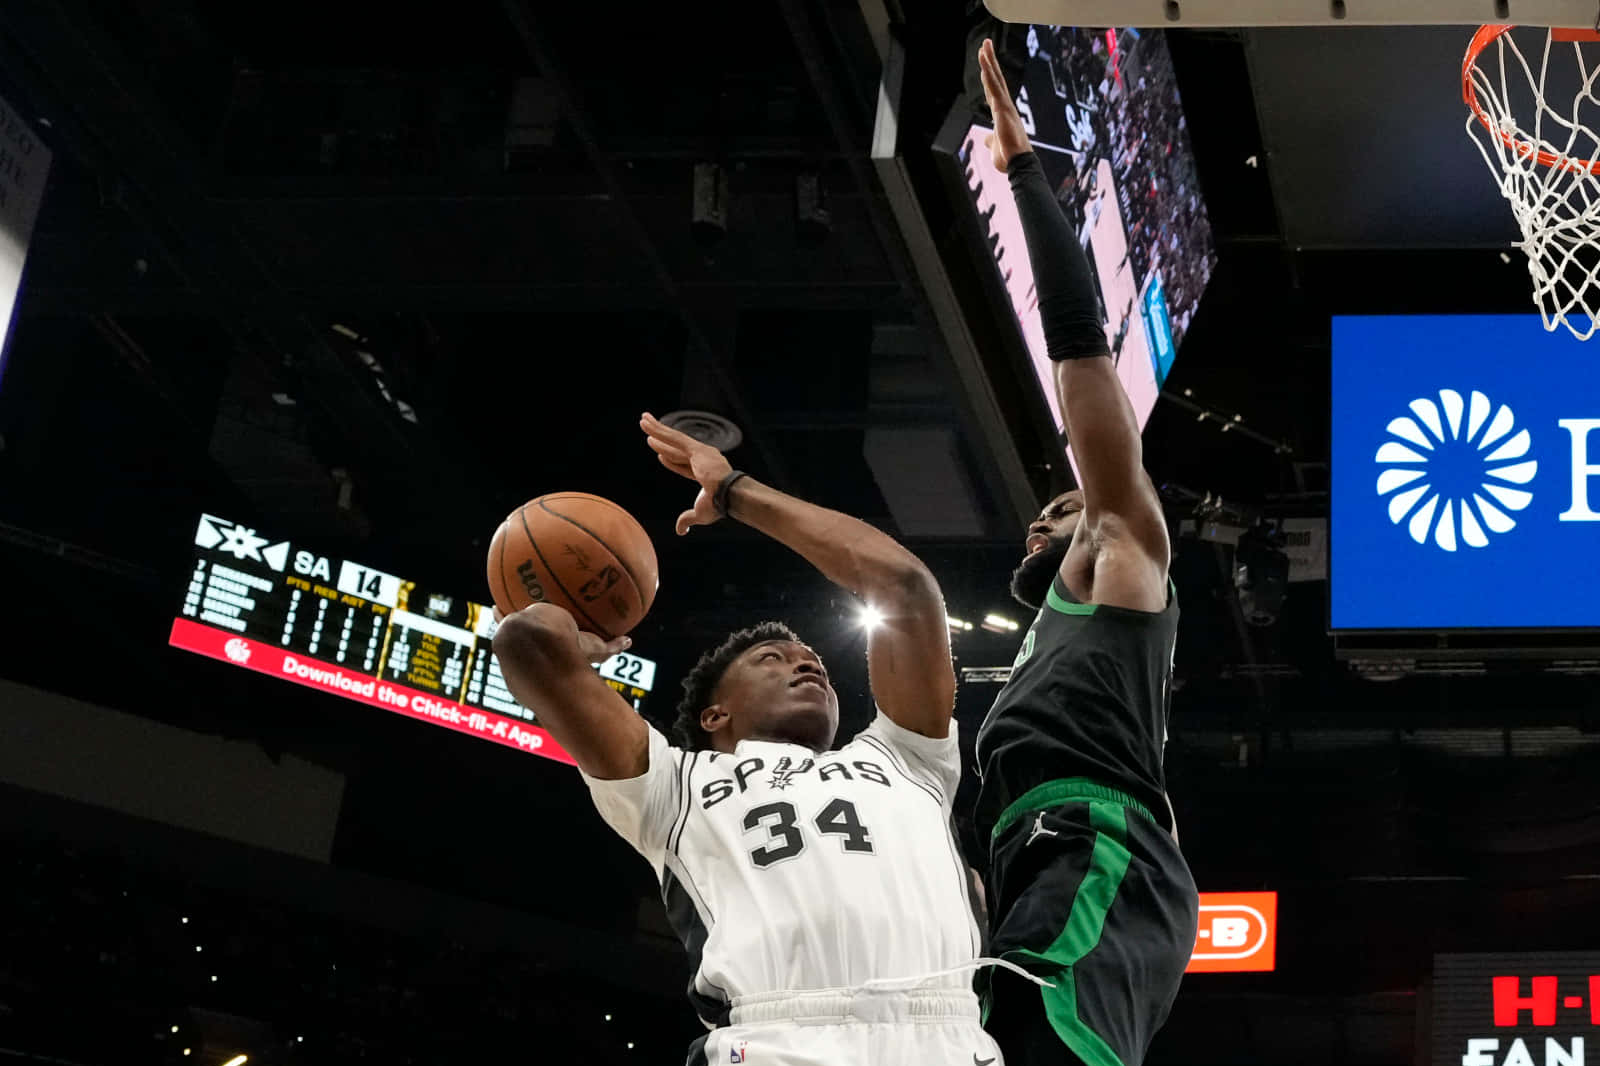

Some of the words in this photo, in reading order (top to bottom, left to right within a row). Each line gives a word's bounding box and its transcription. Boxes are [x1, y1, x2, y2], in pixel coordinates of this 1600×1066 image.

[294, 550, 330, 581] SA
[357, 570, 382, 599] 14
[614, 655, 643, 683] 22
[282, 657, 376, 704] Download
[378, 685, 408, 707] the
[411, 696, 507, 737] Chick-fil-A
[509, 724, 543, 750] App
[742, 797, 877, 871] 34
